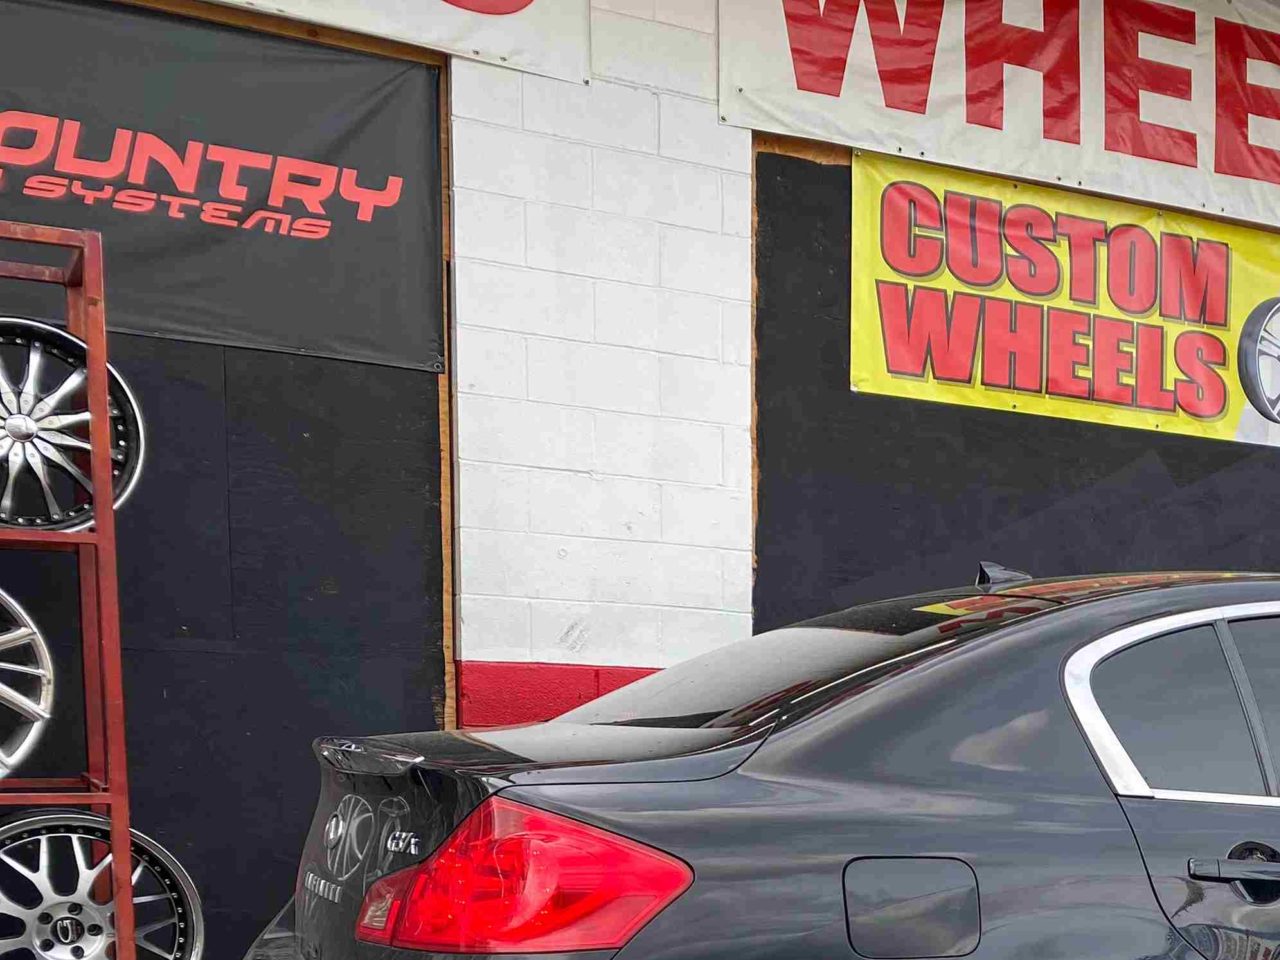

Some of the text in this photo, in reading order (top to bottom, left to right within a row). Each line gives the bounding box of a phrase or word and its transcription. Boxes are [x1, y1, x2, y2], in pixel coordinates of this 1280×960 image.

[0, 110, 403, 222] OUNTRY
[22, 175, 332, 240] SYSTEMS
[878, 180, 1231, 329] CUSTOM
[875, 279, 1229, 421] WHEELS
